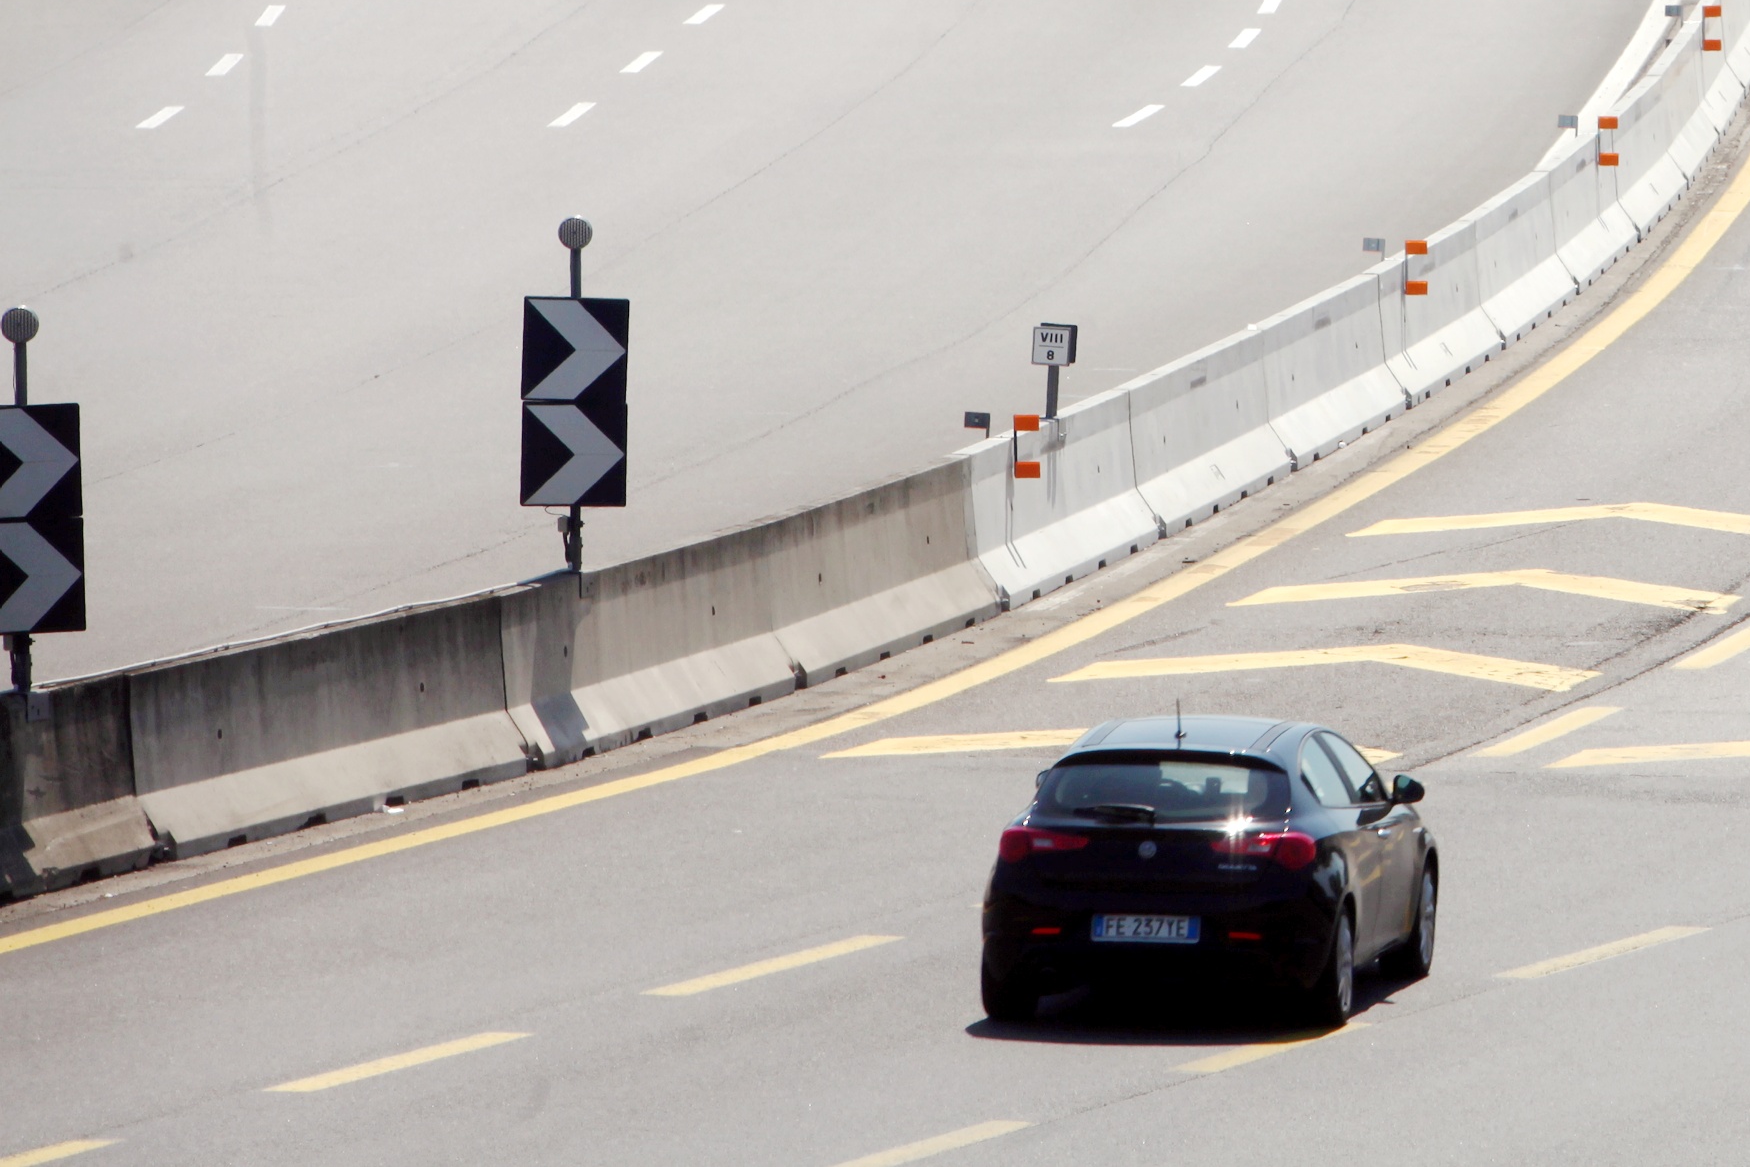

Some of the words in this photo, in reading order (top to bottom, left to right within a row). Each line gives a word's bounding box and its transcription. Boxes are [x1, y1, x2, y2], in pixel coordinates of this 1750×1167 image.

[1040, 332, 1064, 343] VIII
[1046, 350, 1055, 361] 8
[1105, 917, 1127, 936] FE
[1132, 917, 1187, 937] 237YE
